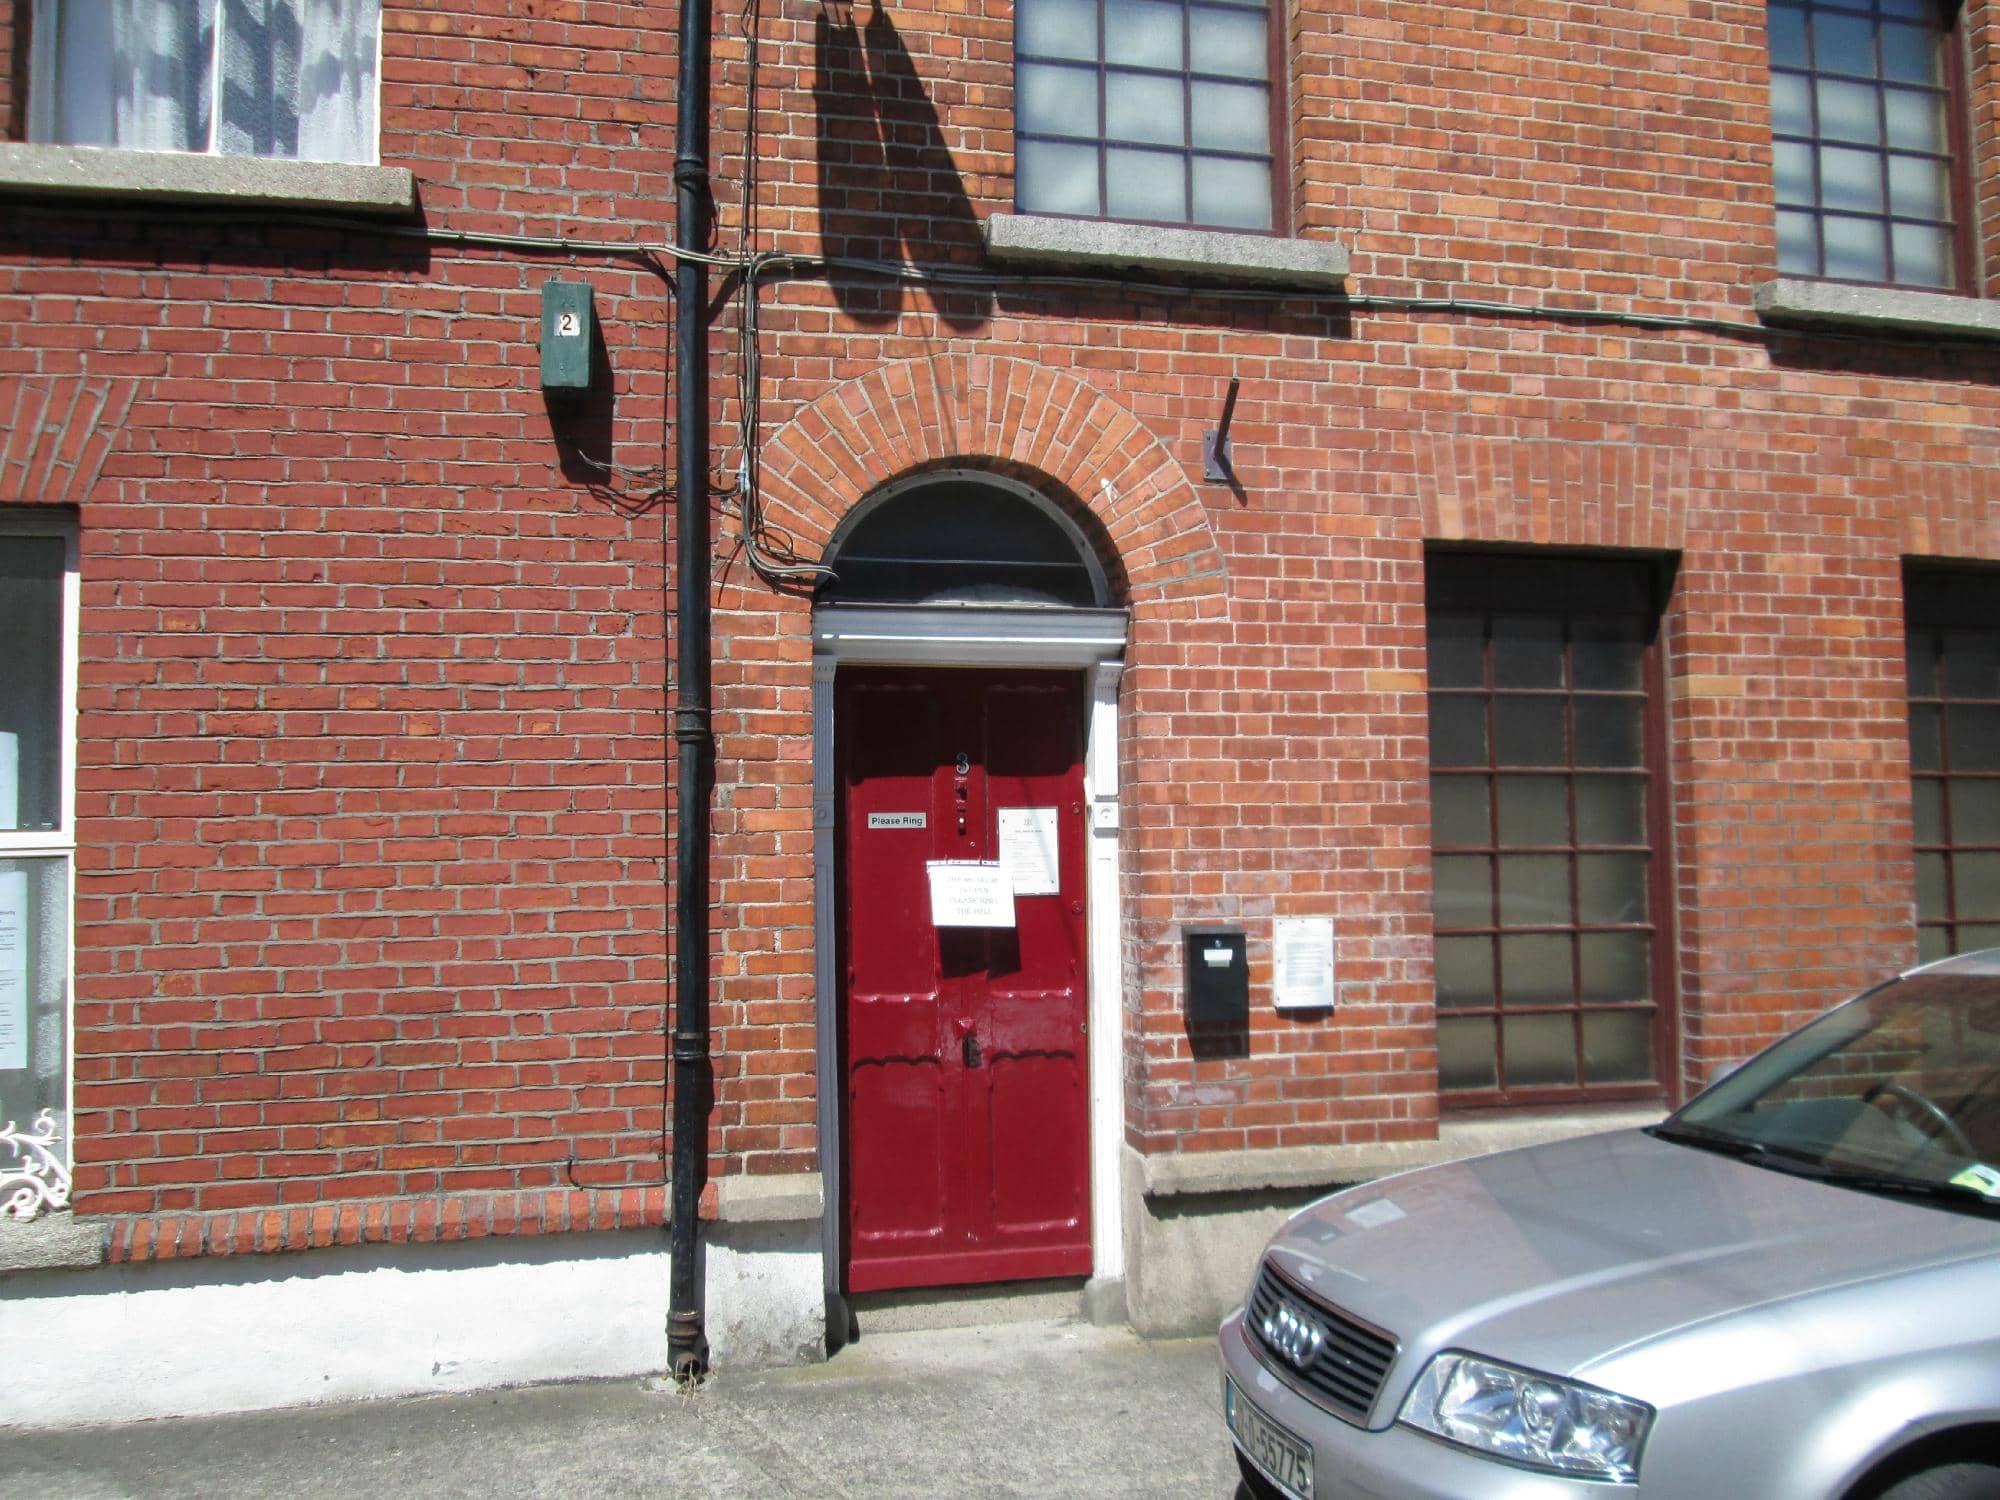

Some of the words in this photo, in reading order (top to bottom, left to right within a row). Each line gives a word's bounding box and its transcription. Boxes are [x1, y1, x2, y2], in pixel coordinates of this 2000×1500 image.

[563, 314, 572, 330] 2
[871, 816, 901, 825] Please
[902, 816, 923, 826] Ring
